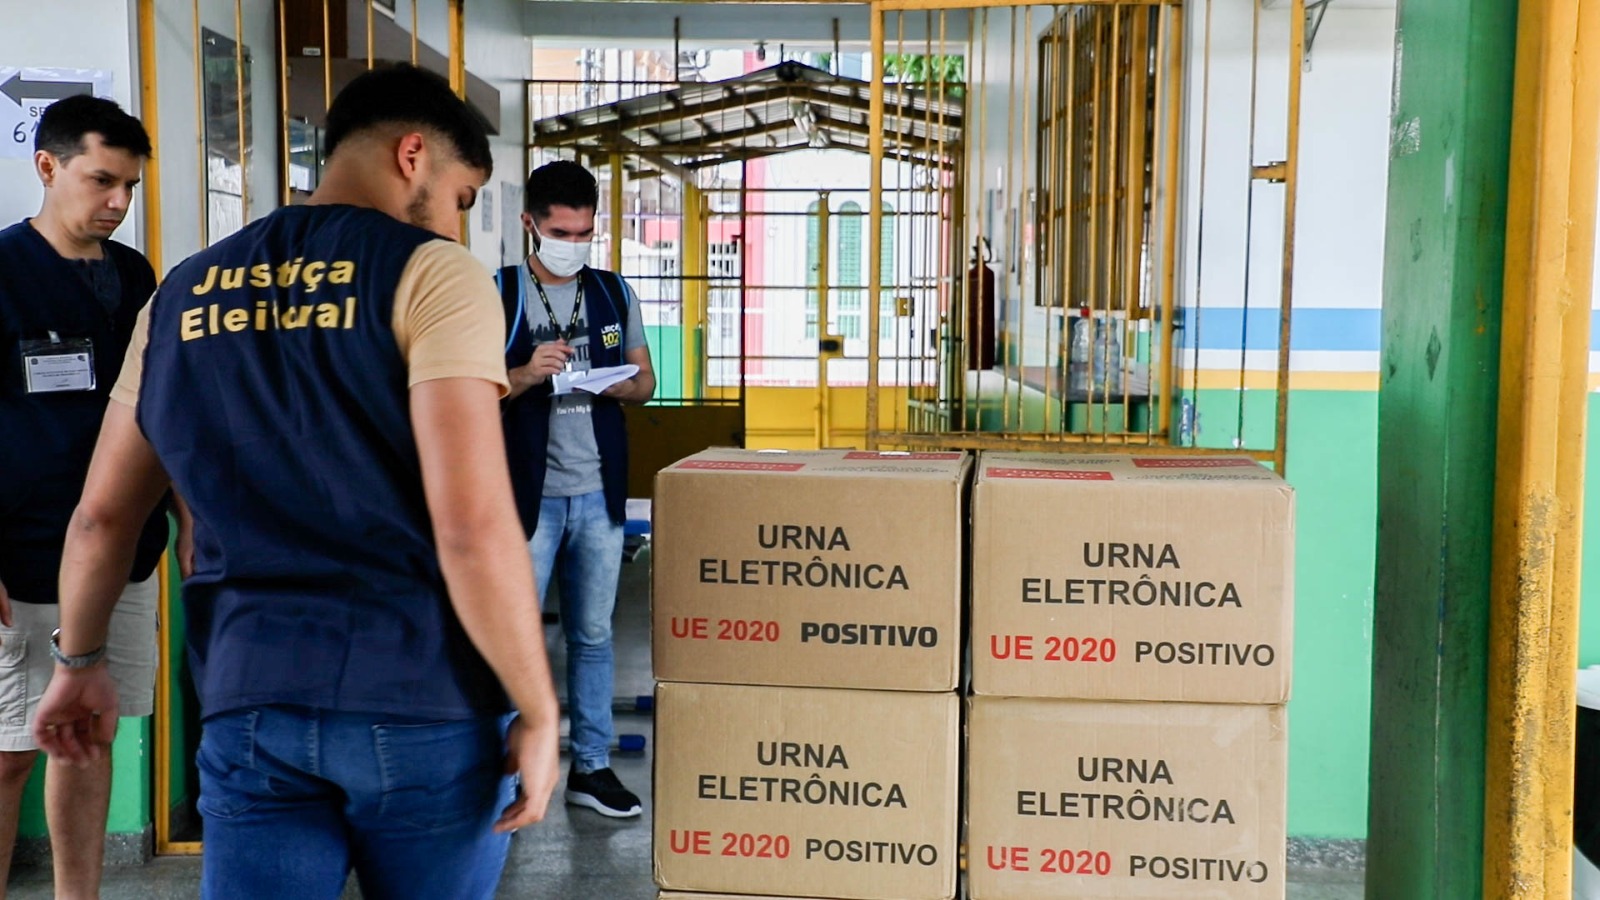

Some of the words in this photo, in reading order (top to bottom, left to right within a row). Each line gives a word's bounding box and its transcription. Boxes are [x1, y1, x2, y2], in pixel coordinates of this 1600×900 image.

[192, 257, 355, 296] Justiça
[758, 524, 850, 550] URNA
[1083, 542, 1180, 569] URNA
[700, 556, 909, 590] ELETRÔNICA
[1021, 574, 1242, 607] ELETRÔNICA
[671, 617, 708, 639] UE
[717, 619, 779, 642] 2020
[801, 622, 937, 648] POSITIVO
[990, 635, 1033, 660] UE
[1044, 636, 1116, 662] 2020
[1135, 641, 1274, 666] POSITIVO
[757, 741, 849, 769] URNA
[1078, 757, 1174, 784] URNA
[698, 773, 907, 808] ELETRÔNICA
[1017, 789, 1235, 824] ELETRÔNICA
[670, 829, 711, 855] UE
[722, 832, 790, 858] 2020
[805, 838, 937, 866] POSITIVO
[987, 846, 1029, 872] UE
[1040, 848, 1111, 875] 2020
[1129, 855, 1268, 883] POSITIVO
